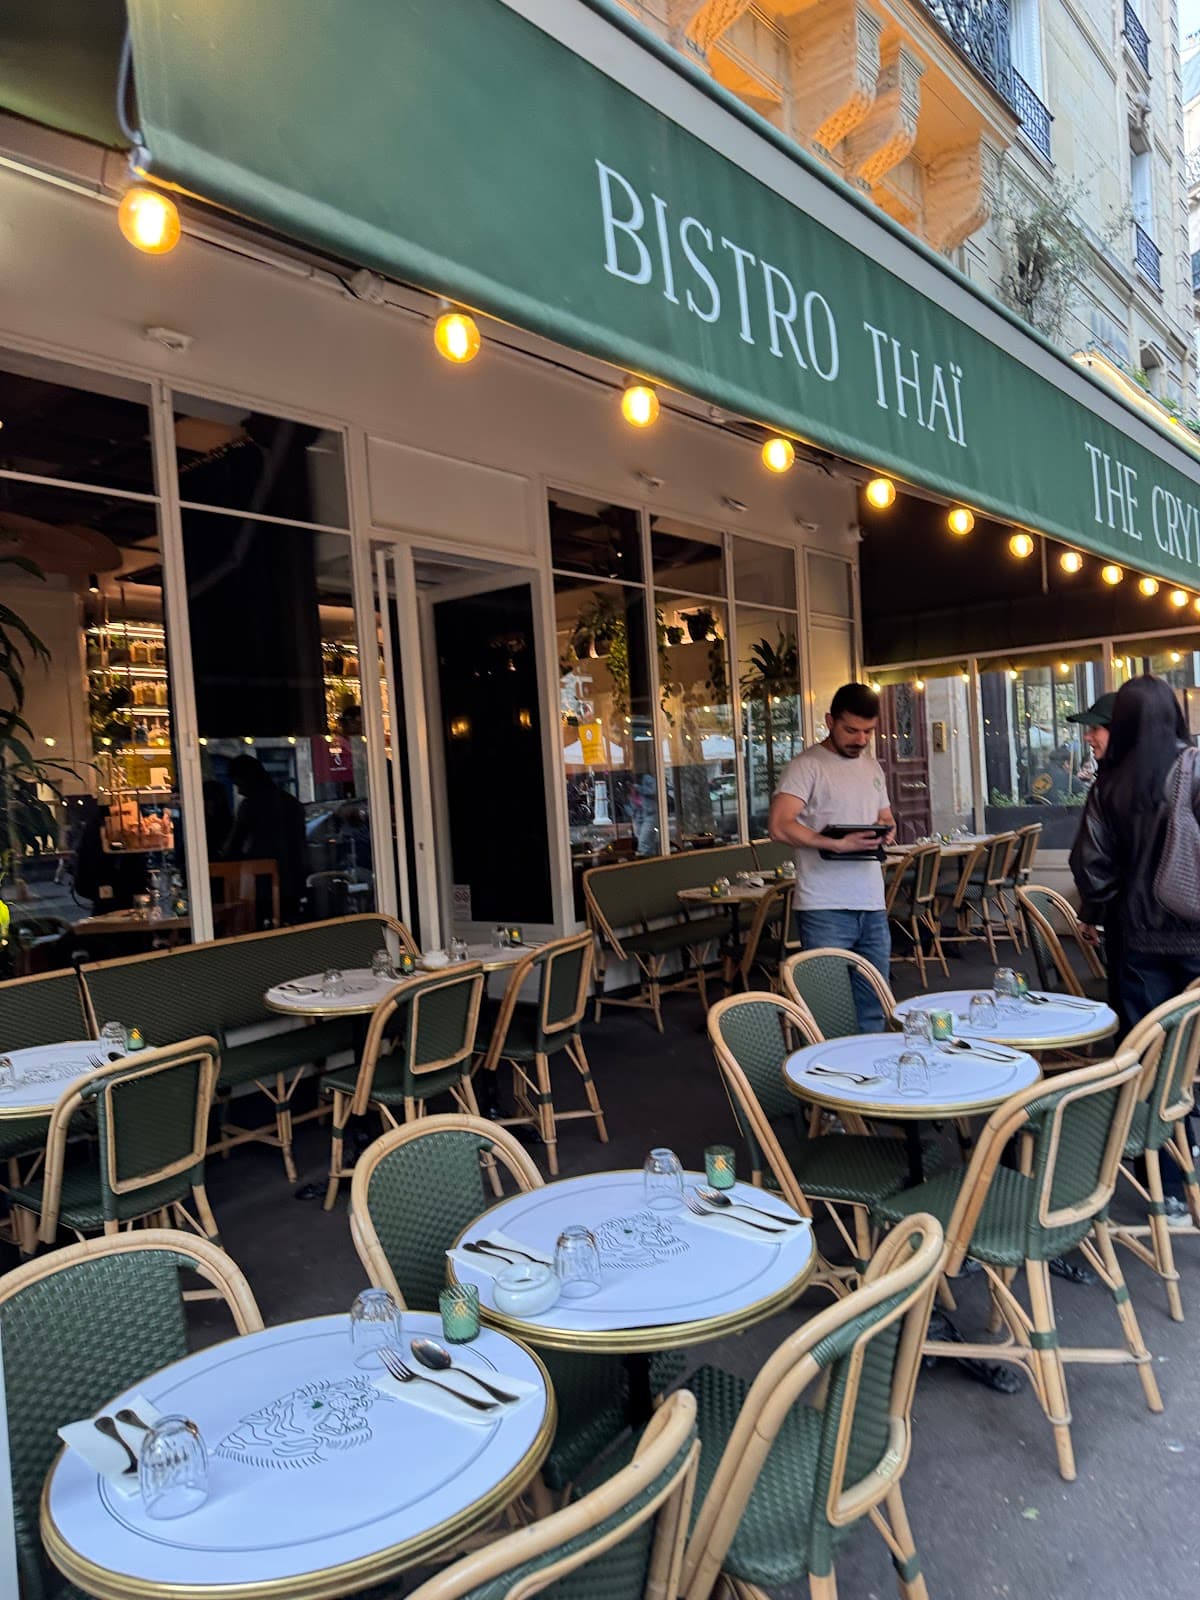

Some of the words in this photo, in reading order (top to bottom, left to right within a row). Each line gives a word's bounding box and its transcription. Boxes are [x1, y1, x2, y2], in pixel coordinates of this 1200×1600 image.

[594, 158, 839, 382] BISTRO
[863, 321, 968, 448] THAÏ
[1084, 441, 1142, 541] THE
